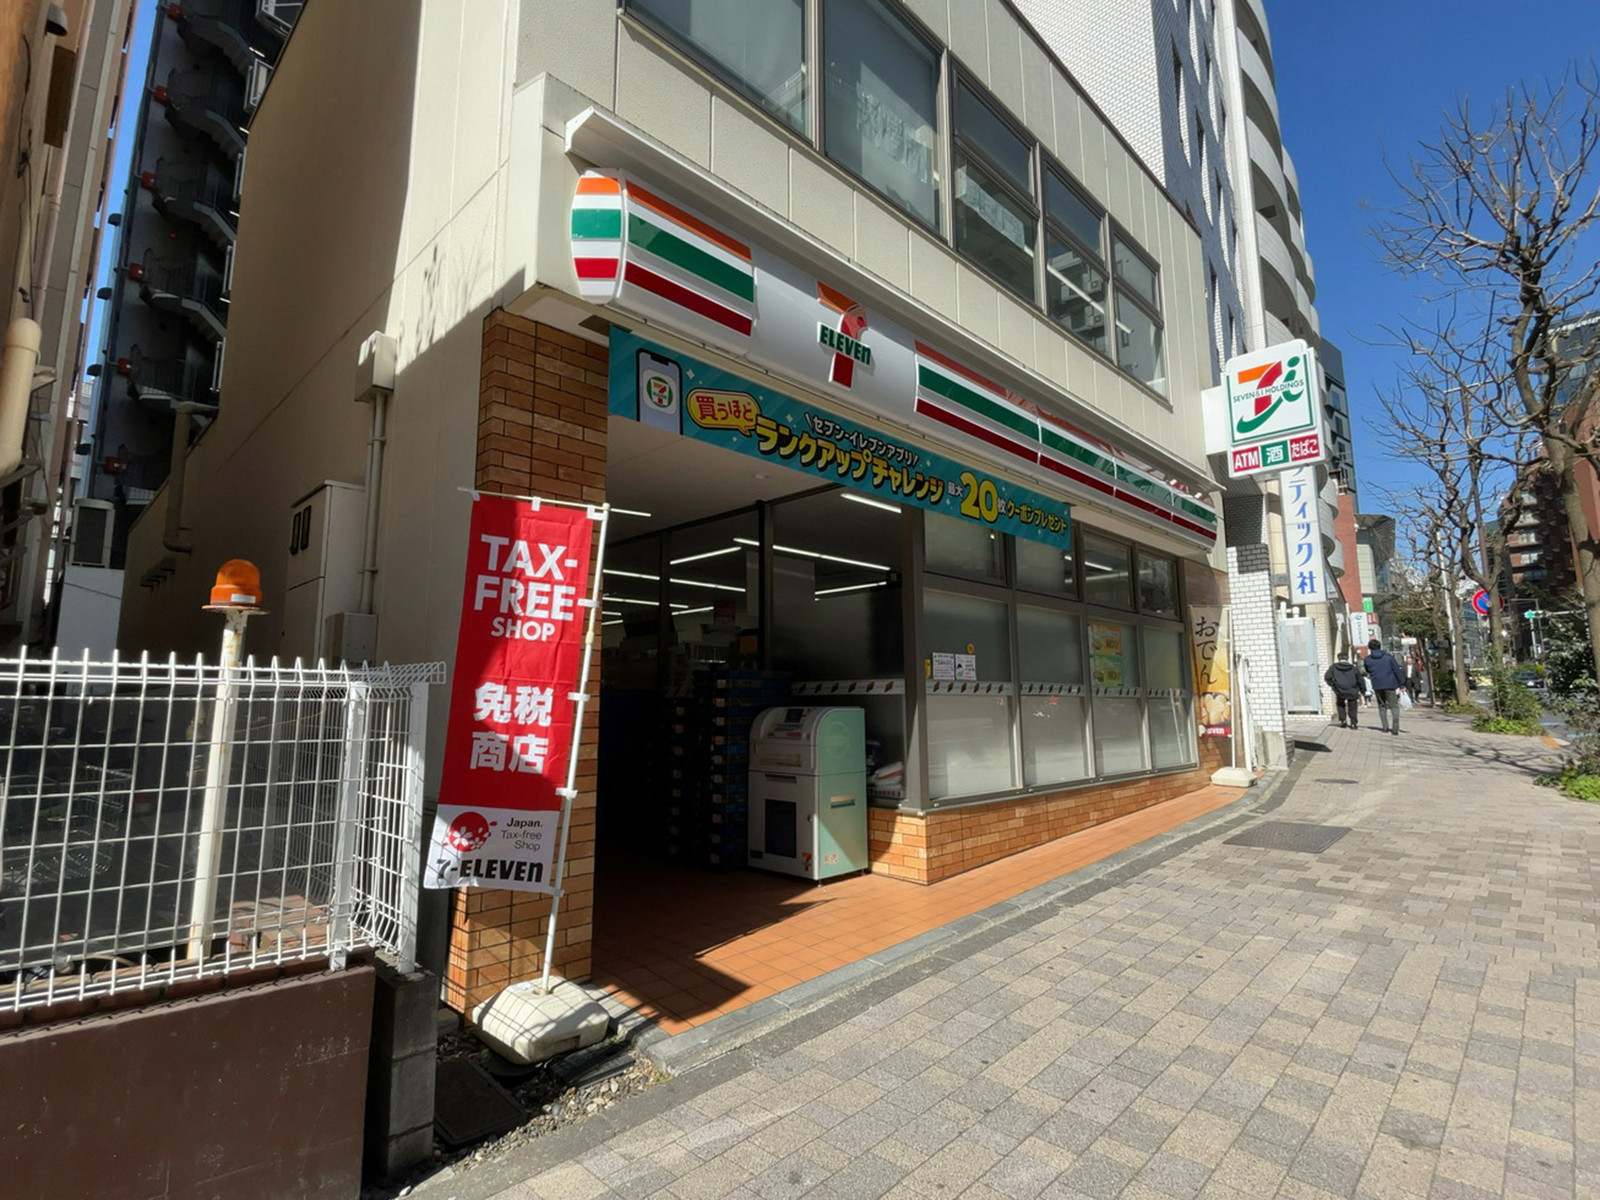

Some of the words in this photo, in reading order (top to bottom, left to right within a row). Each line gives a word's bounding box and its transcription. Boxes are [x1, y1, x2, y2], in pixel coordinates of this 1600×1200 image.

[1265, 379, 1304, 396] HOLDINGS
[695, 395, 754, 423] 買うほど
[755, 414, 945, 503] ランクアップチャレンジ
[1234, 450, 1259, 470] ATM
[1266, 445, 1284, 464] 酒
[1291, 438, 1319, 458] たばこ
[480, 534, 578, 580] TAX-
[474, 574, 576, 621] FREE
[491, 616, 556, 642] SHOP
[1195, 616, 1219, 685] おでん
[473, 681, 554, 727] 免税
[469, 730, 549, 774] 商店
[501, 830, 542, 841] Tax-free
[506, 817, 544, 829] Japan.
[514, 840, 541, 852] Shop
